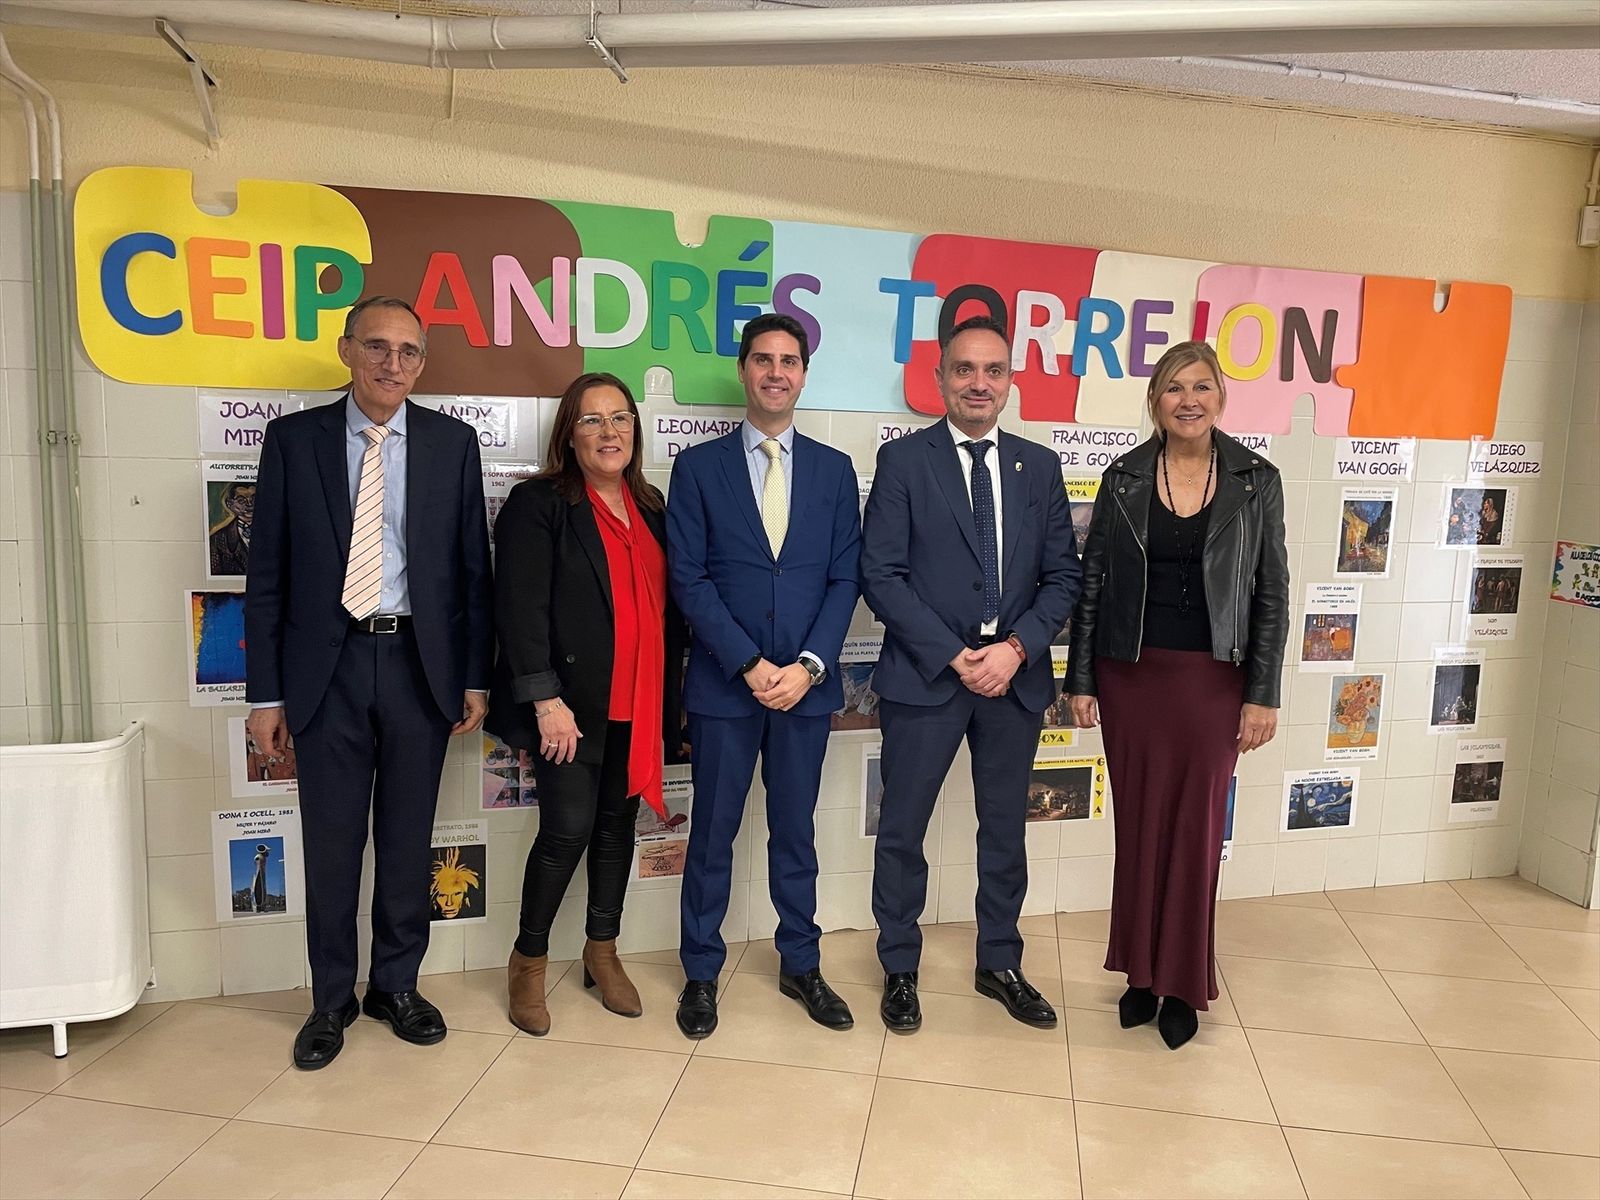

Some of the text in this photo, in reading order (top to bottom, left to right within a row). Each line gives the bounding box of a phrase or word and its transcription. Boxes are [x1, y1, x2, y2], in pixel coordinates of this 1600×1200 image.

[100, 231, 364, 341] CEIP
[412, 241, 821, 357] ANDRÉS
[220, 401, 282, 419] JOAN
[881, 426, 923, 441] JOA
[1052, 430, 1137, 447] FRANCISCO
[1351, 441, 1400, 455] VICENT
[1490, 444, 1526, 456] DIEGO
[1059, 451, 1126, 467] DE GOY
[1470, 458, 1541, 474] VELÁZQUEZ
[1338, 461, 1408, 475] VAN GOGH
[196, 685, 206, 693] LA
[1039, 733, 1065, 744] OYA
[1094, 757, 1105, 814] GOYA
[218, 812, 242, 820] DONA
[441, 834, 480, 843] WARHOL
